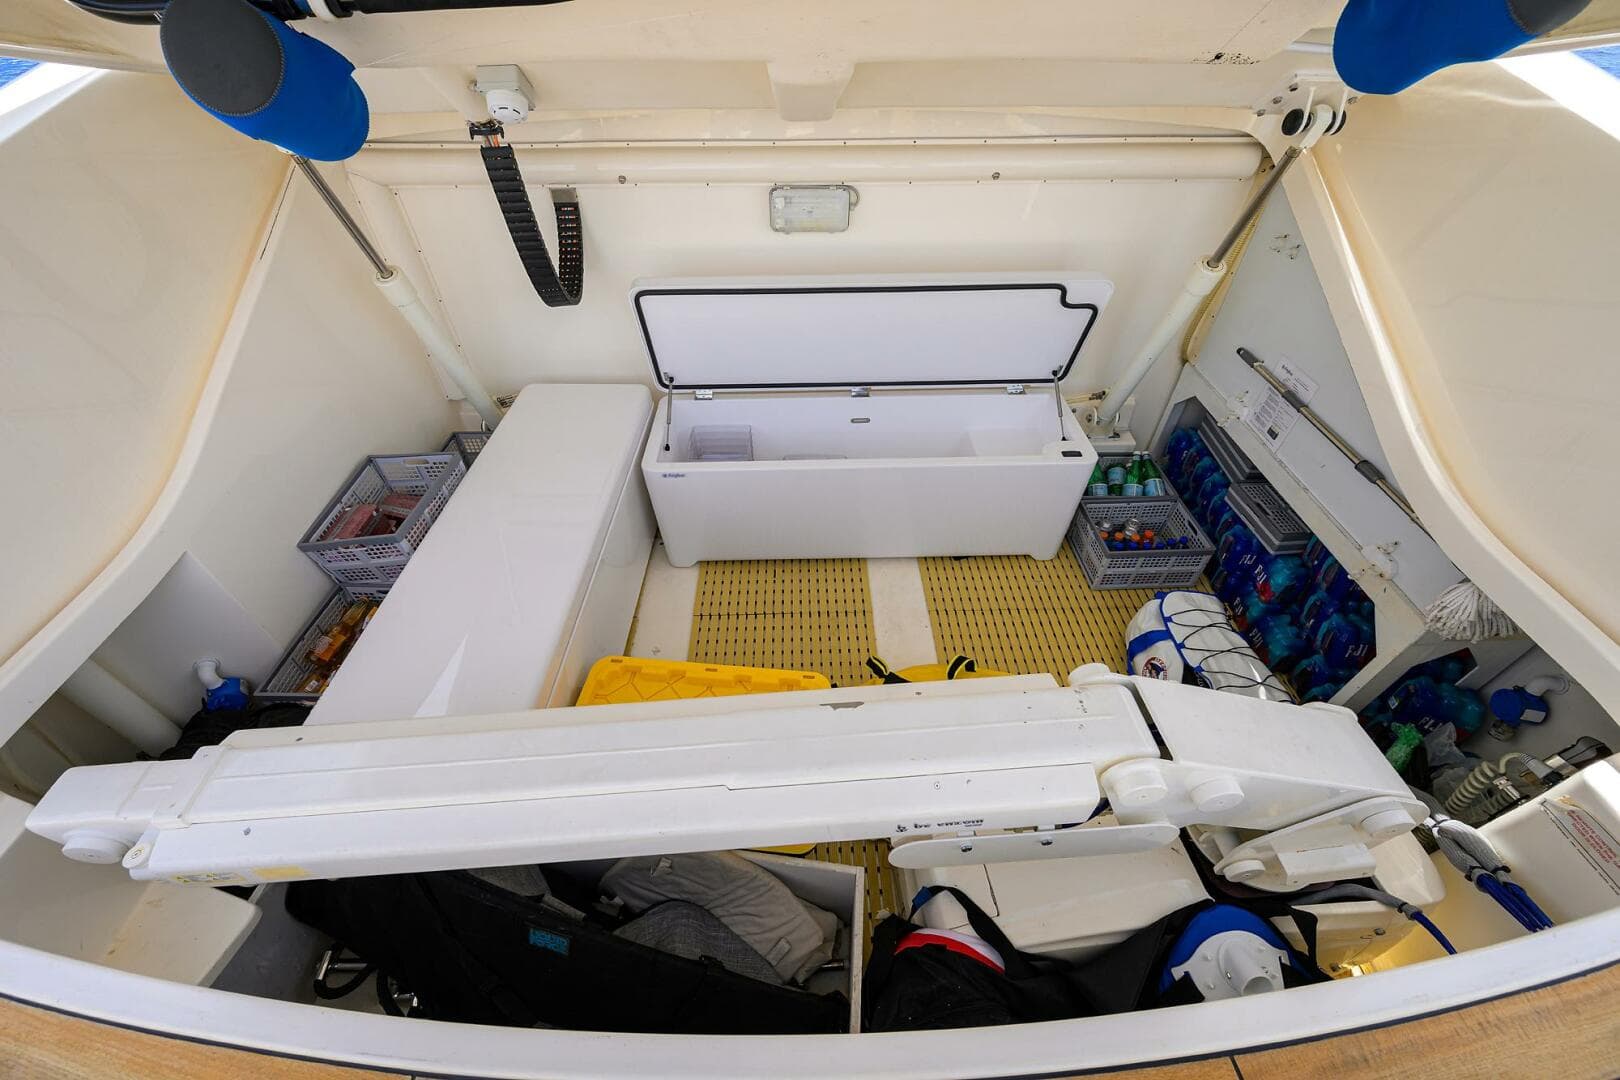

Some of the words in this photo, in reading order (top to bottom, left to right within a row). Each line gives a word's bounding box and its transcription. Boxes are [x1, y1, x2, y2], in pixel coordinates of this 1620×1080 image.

[1254, 564, 1267, 584] FJI
[1233, 597, 1244, 615] FJI
[1344, 643, 1369, 658] FJI
[1418, 716, 1443, 731] FIJ
